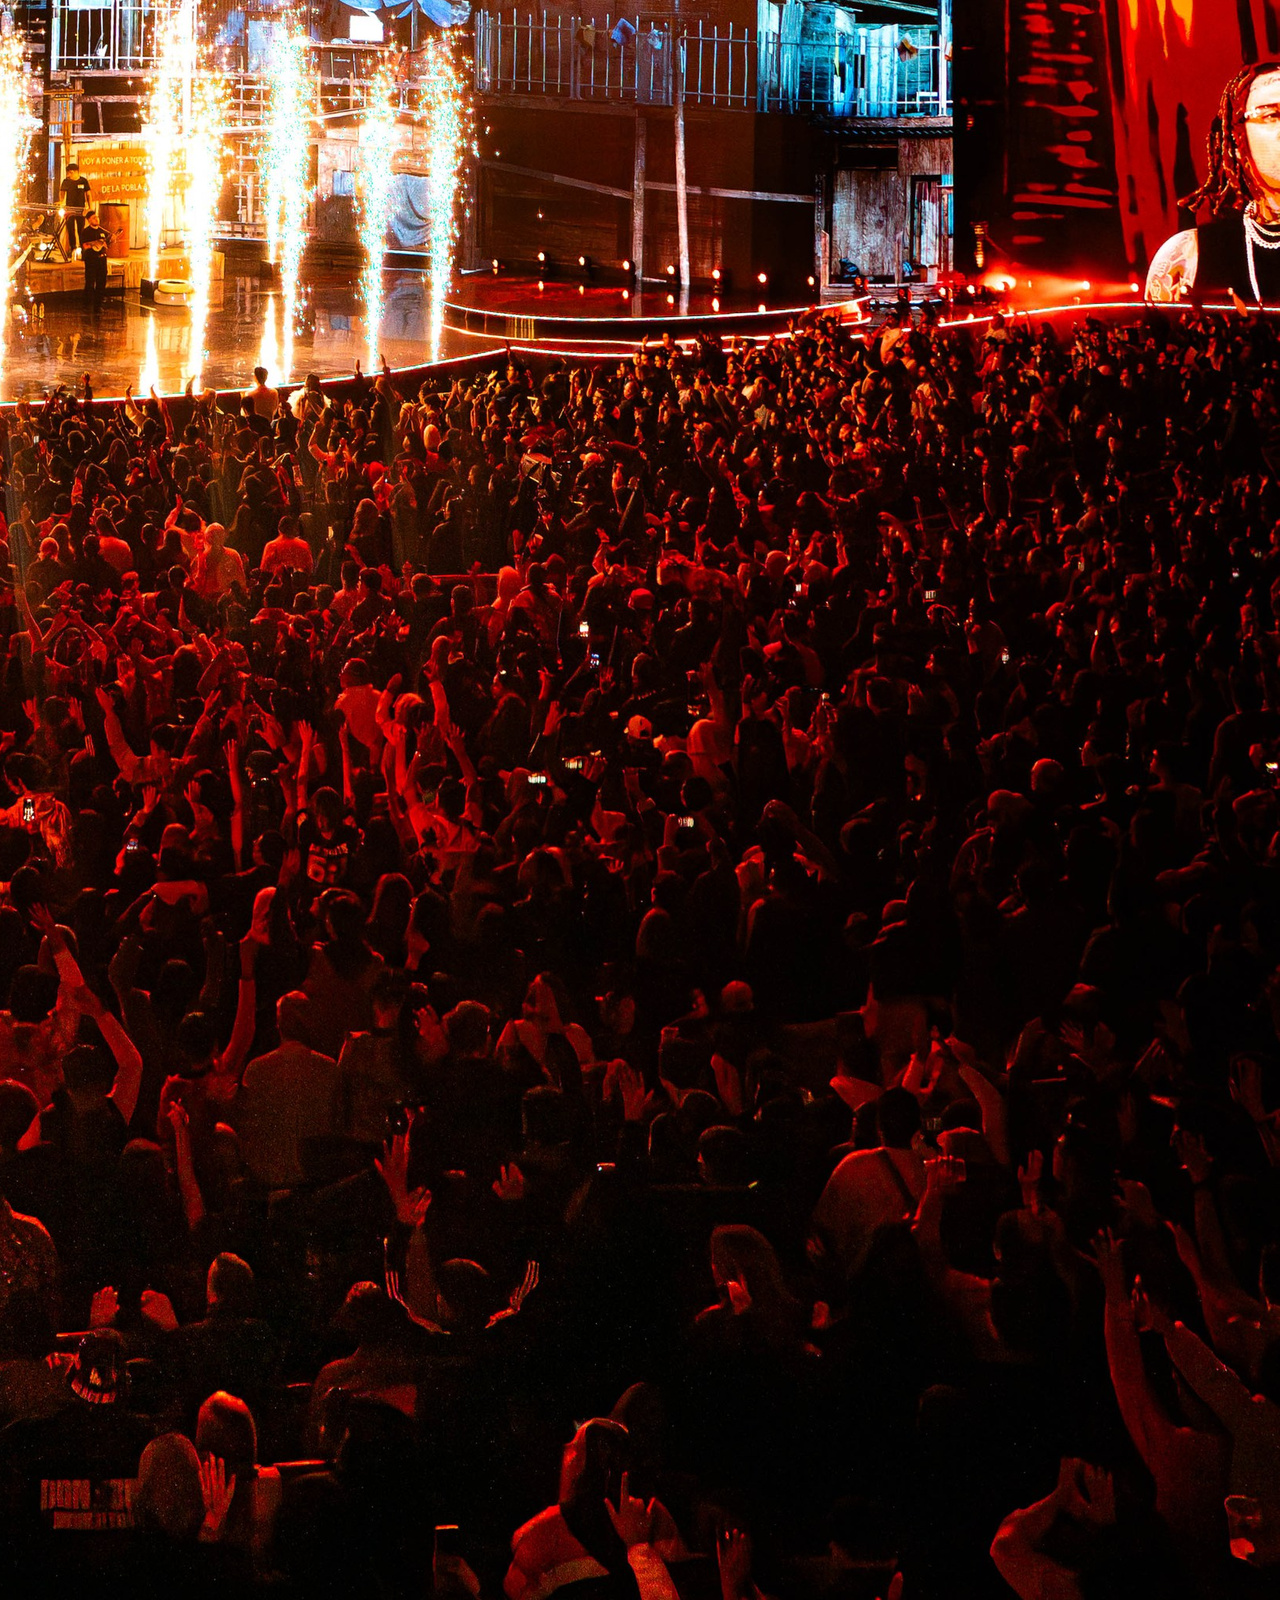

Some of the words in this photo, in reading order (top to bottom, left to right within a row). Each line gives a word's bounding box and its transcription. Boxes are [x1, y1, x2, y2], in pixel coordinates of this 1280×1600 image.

[81, 157, 94, 165] VOY
[101, 156, 123, 165] PONER
[101, 185, 111, 194] DE
[111, 185, 120, 193] LA
